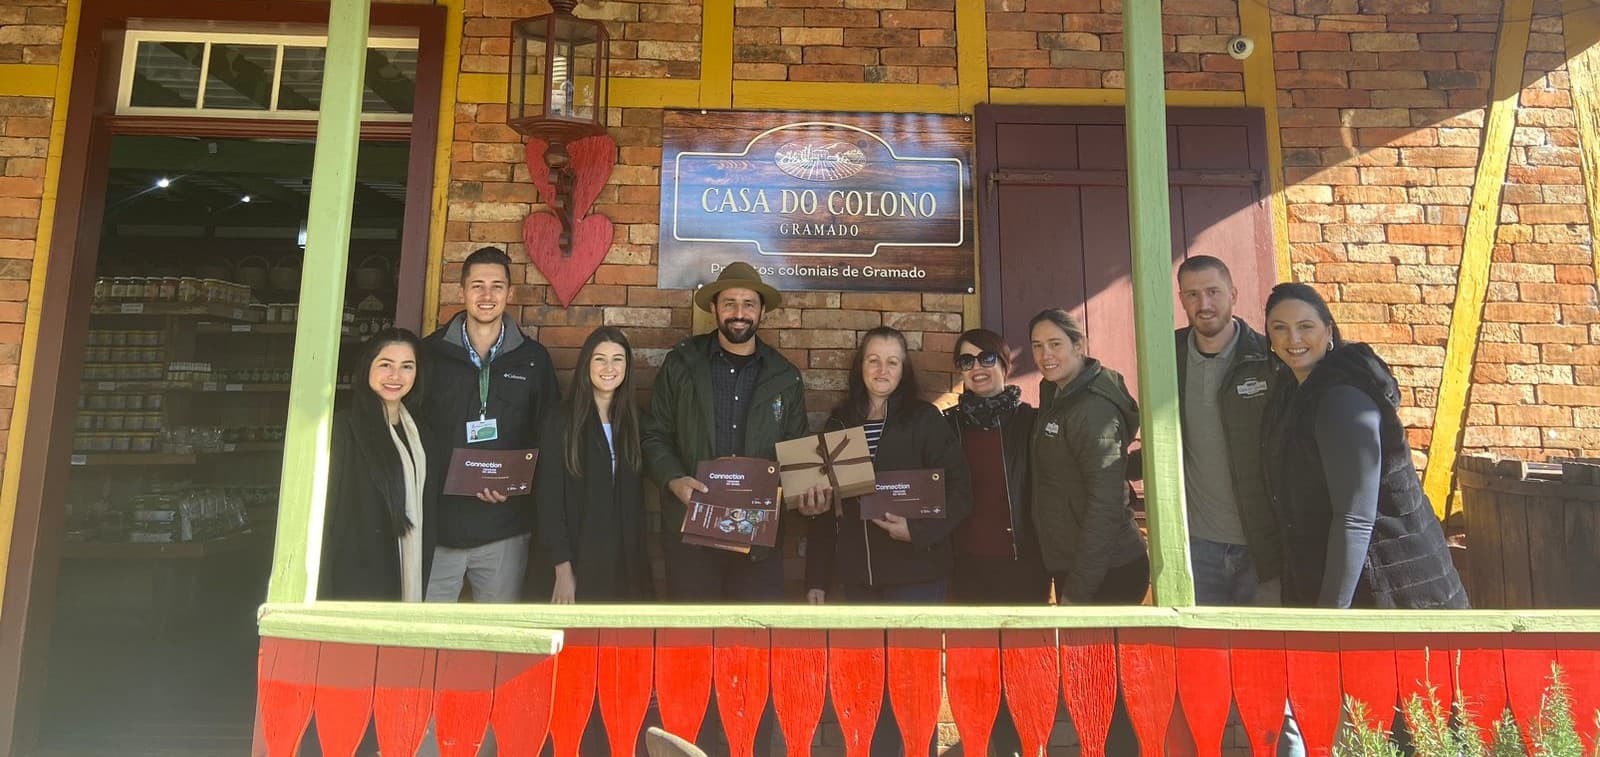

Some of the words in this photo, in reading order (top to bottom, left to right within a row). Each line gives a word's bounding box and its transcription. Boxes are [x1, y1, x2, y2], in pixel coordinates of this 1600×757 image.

[702, 188, 770, 213] CASA
[780, 189, 818, 215] DO
[828, 190, 938, 218] COLONO
[780, 223, 859, 237] GRAMADO
[711, 263, 774, 276] Pros
[778, 264, 838, 278] coloniais
[842, 266, 859, 278] de
[863, 266, 927, 279] Gramado
[464, 460, 502, 469] Connection
